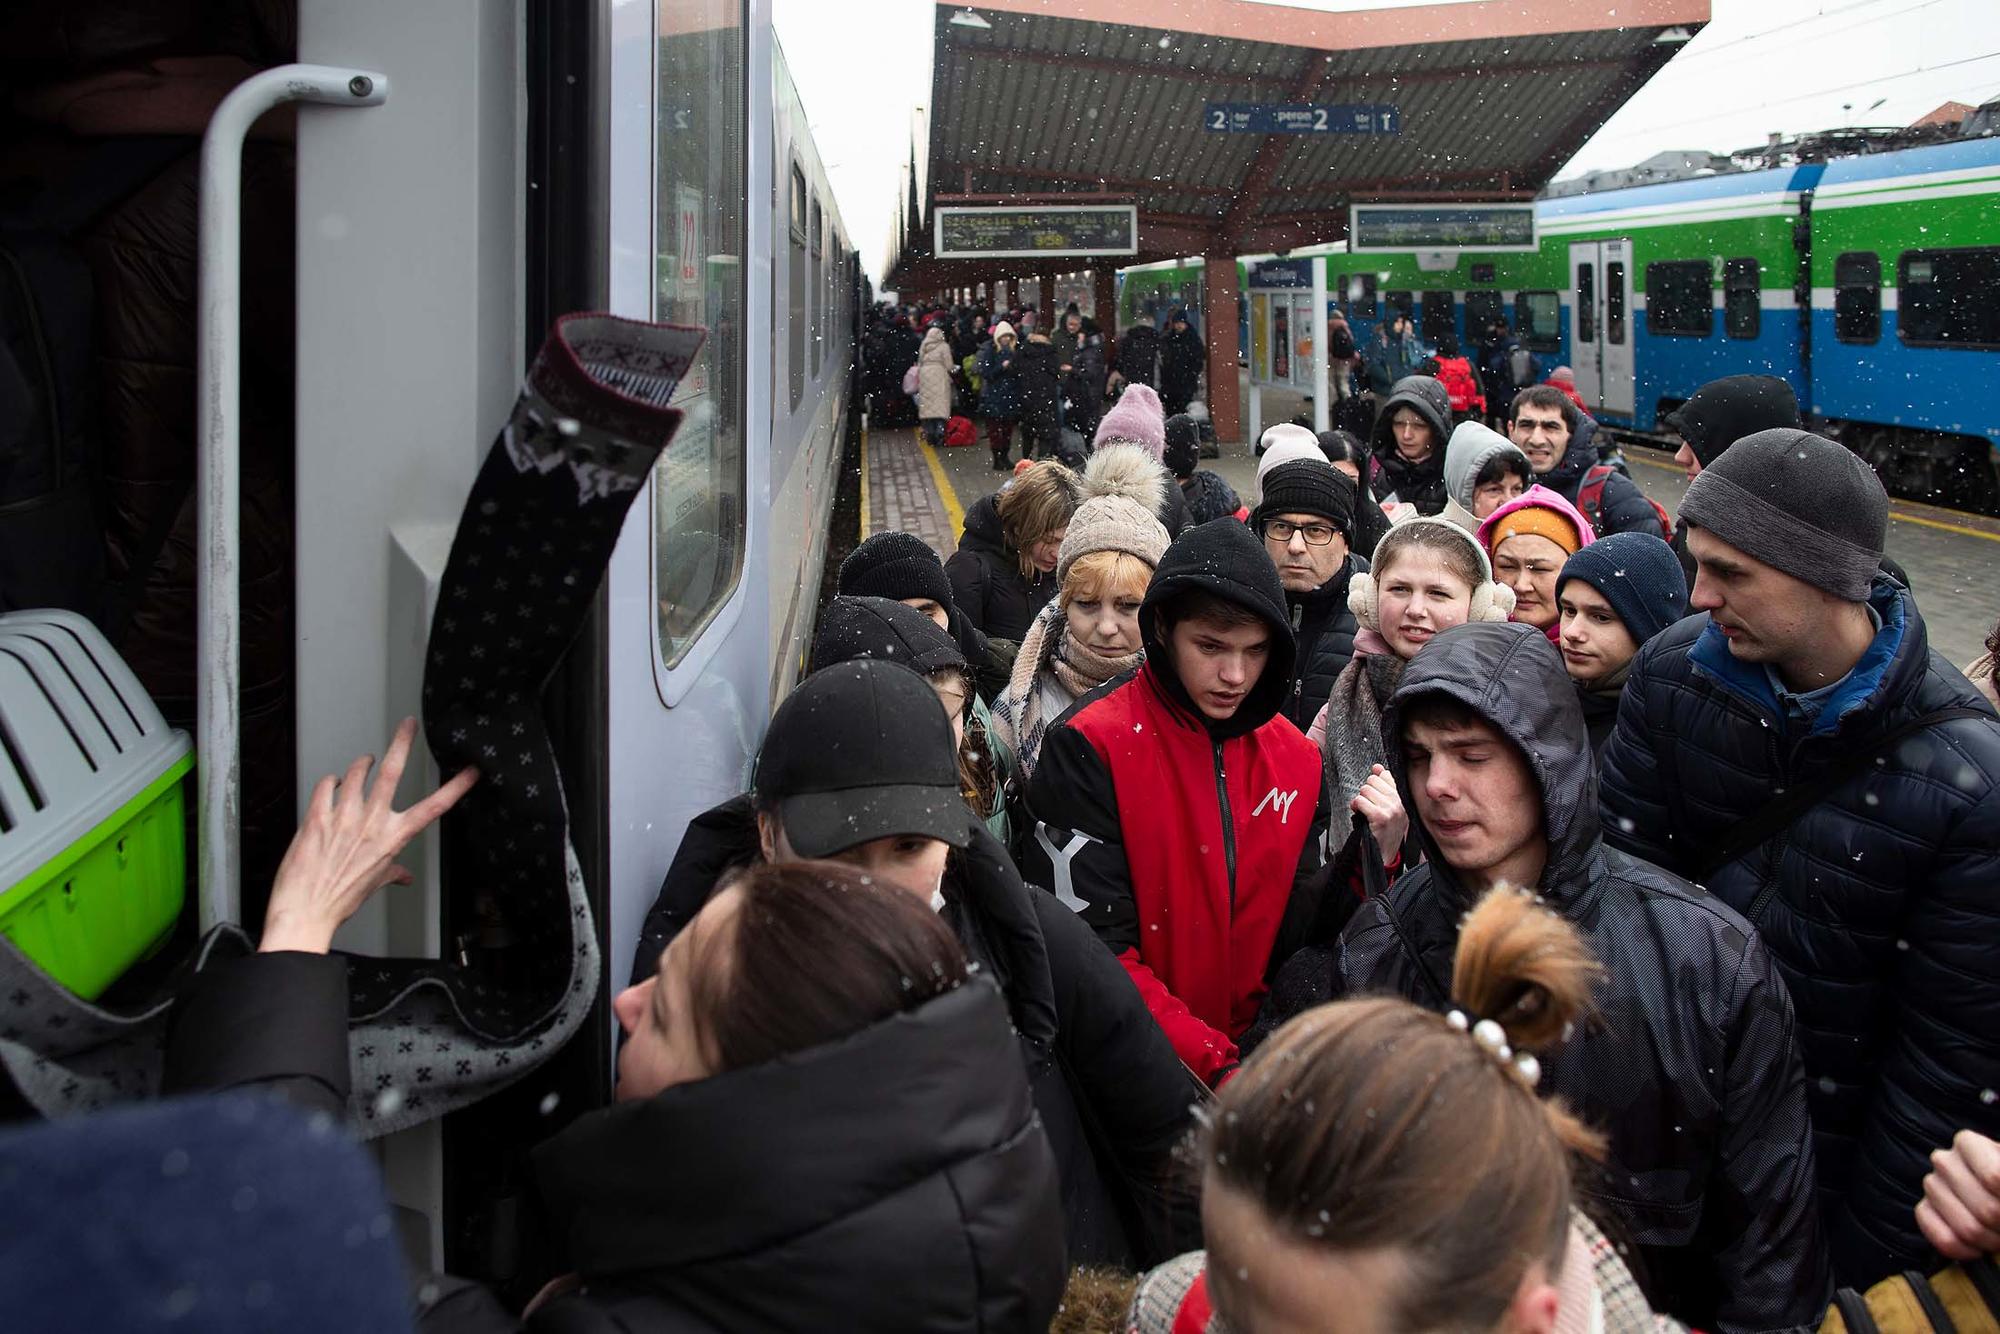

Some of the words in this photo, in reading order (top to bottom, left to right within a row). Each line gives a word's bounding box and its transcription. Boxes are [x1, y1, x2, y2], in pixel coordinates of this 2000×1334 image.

[1213, 111, 1225, 129] 2
[1277, 111, 1312, 123] peron
[1313, 109, 1328, 130] 2
[1381, 112, 1391, 131] 1
[1712, 255, 1725, 282] 2
